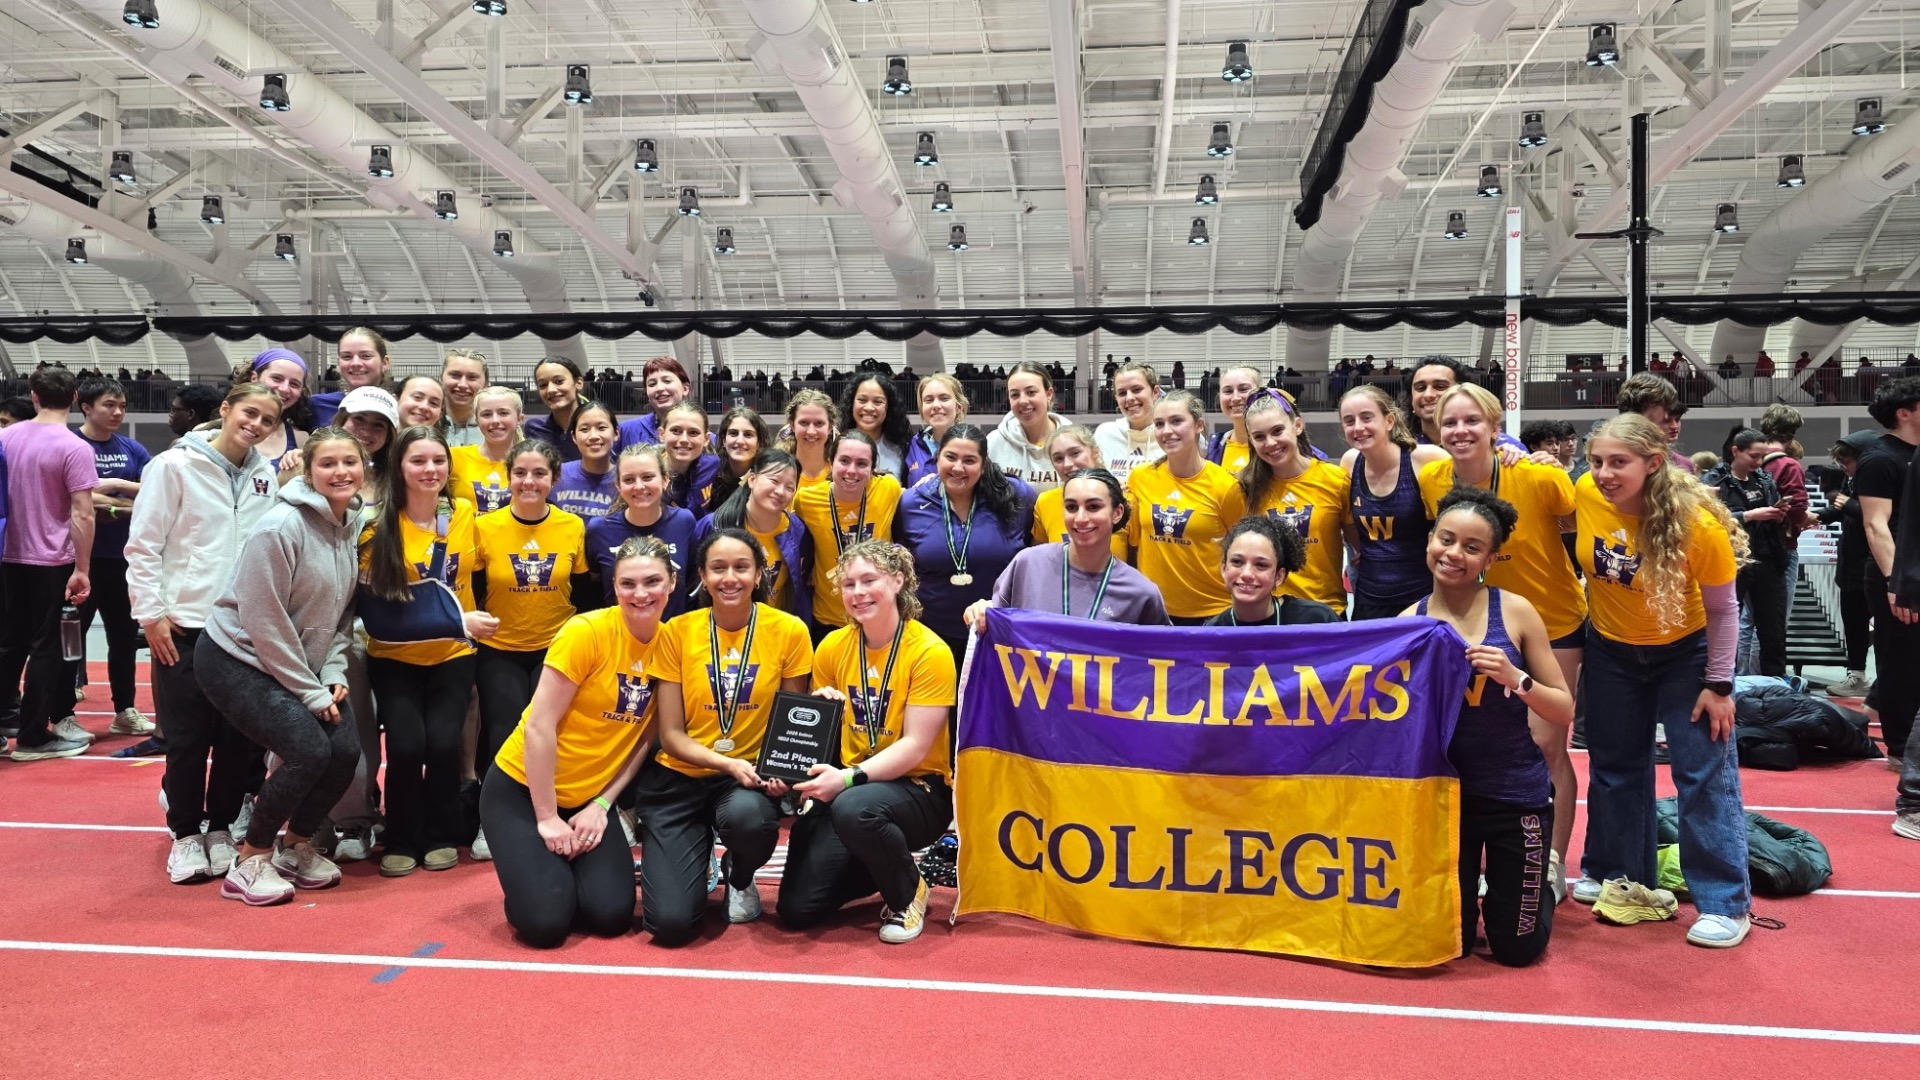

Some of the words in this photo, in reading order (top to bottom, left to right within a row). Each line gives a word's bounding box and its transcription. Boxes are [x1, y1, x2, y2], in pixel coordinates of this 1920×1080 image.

[1506, 313, 1518, 344] new
[1506, 347, 1520, 411] balance
[733, 397, 745, 408] 13
[1576, 389, 1587, 400] 11
[1359, 515, 1395, 541] W
[994, 643, 1411, 727] WILLIAMS
[602, 711, 625, 722] TRACK
[766, 759, 798, 770] Women's
[771, 750, 790, 760] 2nd
[791, 752, 818, 765] Place
[997, 809, 1401, 910] COLLEGE
[1517, 814, 1543, 936] WILLIAMS
